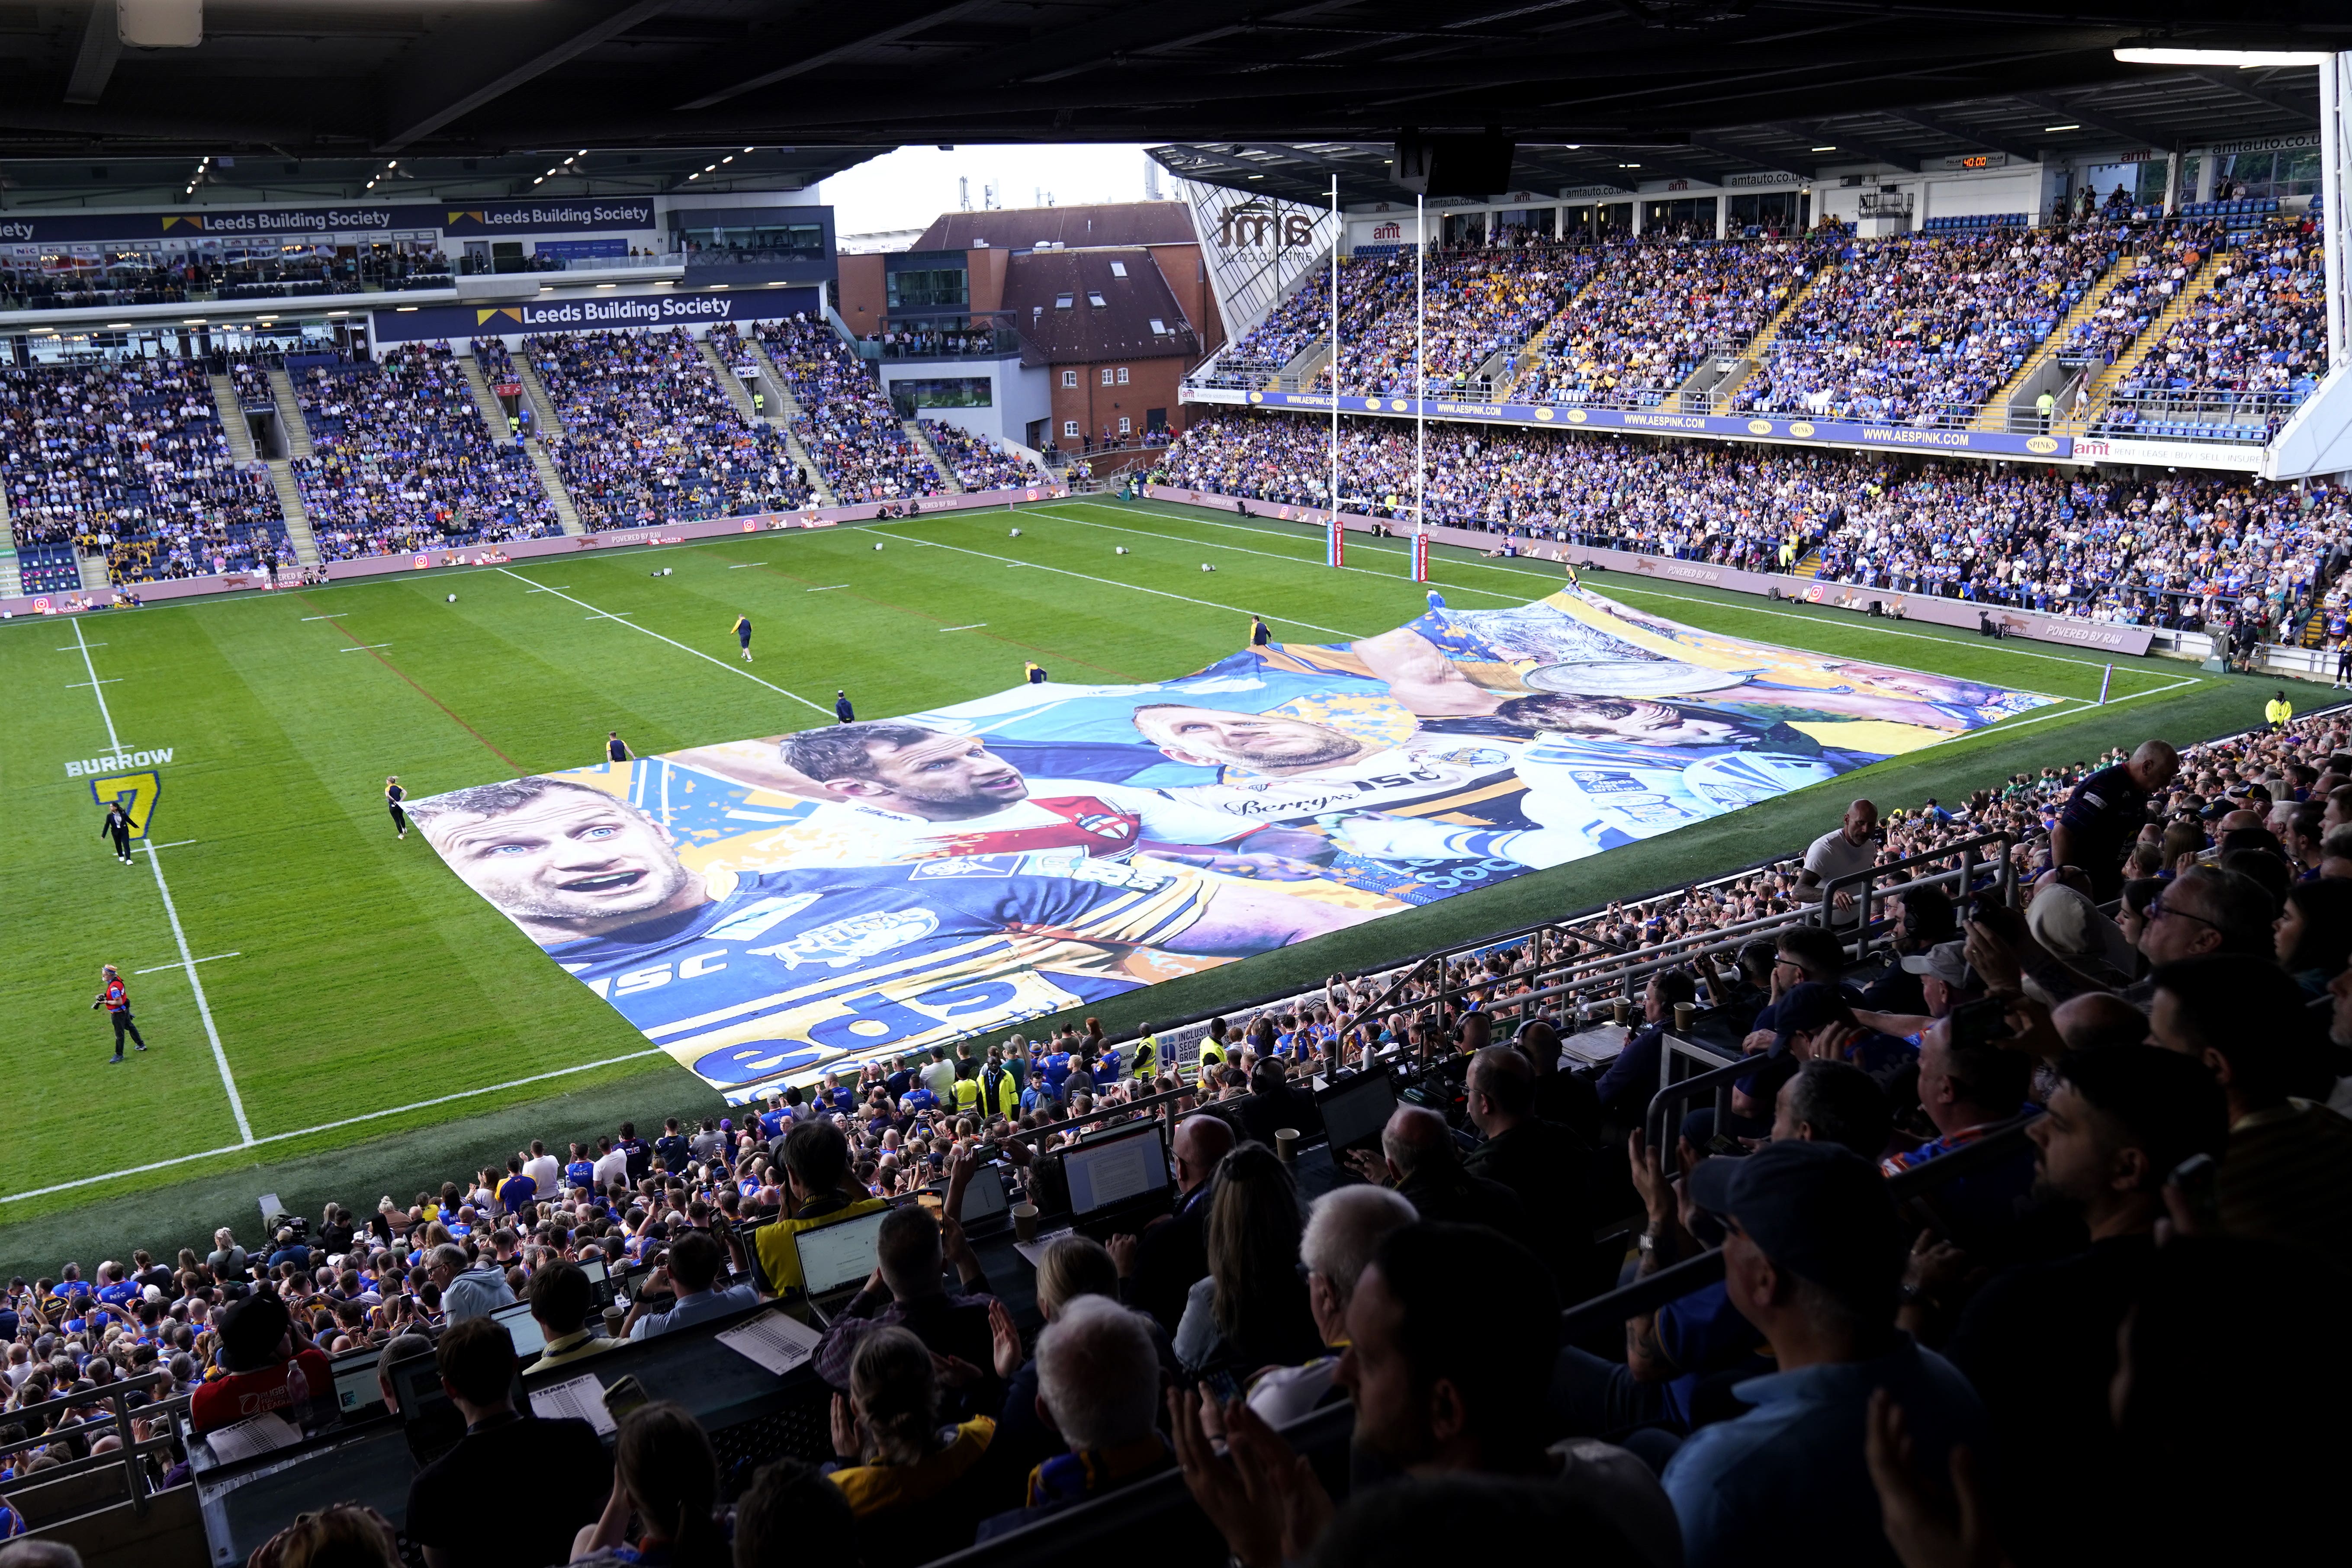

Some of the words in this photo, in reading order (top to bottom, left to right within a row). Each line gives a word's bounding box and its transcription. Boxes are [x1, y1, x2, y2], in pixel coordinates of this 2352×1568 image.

[2121, 149, 2151, 161] amt
[1963, 157, 1986, 167] 40:00
[1668, 180, 1688, 190] amt
[1514, 193, 1531, 202] amt
[203, 215, 256, 231] Leeds
[259, 212, 326, 230] Building
[328, 210, 390, 228] Society
[484, 210, 530, 224] Leeds
[533, 208, 591, 224] Building
[594, 206, 648, 222] Society
[1374, 224, 1401, 239] amt
[523, 304, 582, 324] Leeds
[585, 300, 659, 320] Building
[663, 297, 731, 317] Society
[1437, 404, 1501, 416] WWW.AESPINK.COM
[1624, 414, 1705, 428] WWW.AESPINK.COM
[1792, 426, 1812, 434] SPINKS
[1864, 429, 1969, 446] WWW.AESPINK.COM
[2029, 441, 2056, 450] SPINKS
[2074, 443, 2110, 456] amt
[2143, 450, 2168, 458] LEASE
[2201, 453, 2219, 461] SELL
[2228, 455, 2261, 464] INSURE
[612, 534, 640, 543] POWERED
[264, 572, 296, 583] PERED
[1667, 566, 1696, 578] POWERED
[1696, 570, 1706, 580] BY
[1705, 572, 1719, 582] RAW
[2046, 625, 2088, 640] POWERED
[2088, 631, 2103, 642] BY
[2103, 633, 2123, 645] RAW
[65, 748, 173, 777] BURROW
[90, 770, 161, 841] 7
[1030, 1235, 1053, 1245] TEAM
[730, 1321, 753, 1333] TEAM
[260, 1384, 289, 1399] RUGBY
[536, 1384, 566, 1397] TEAM
[567, 1378, 584, 1387] SHEET
[225, 1420, 250, 1432] TEAM
